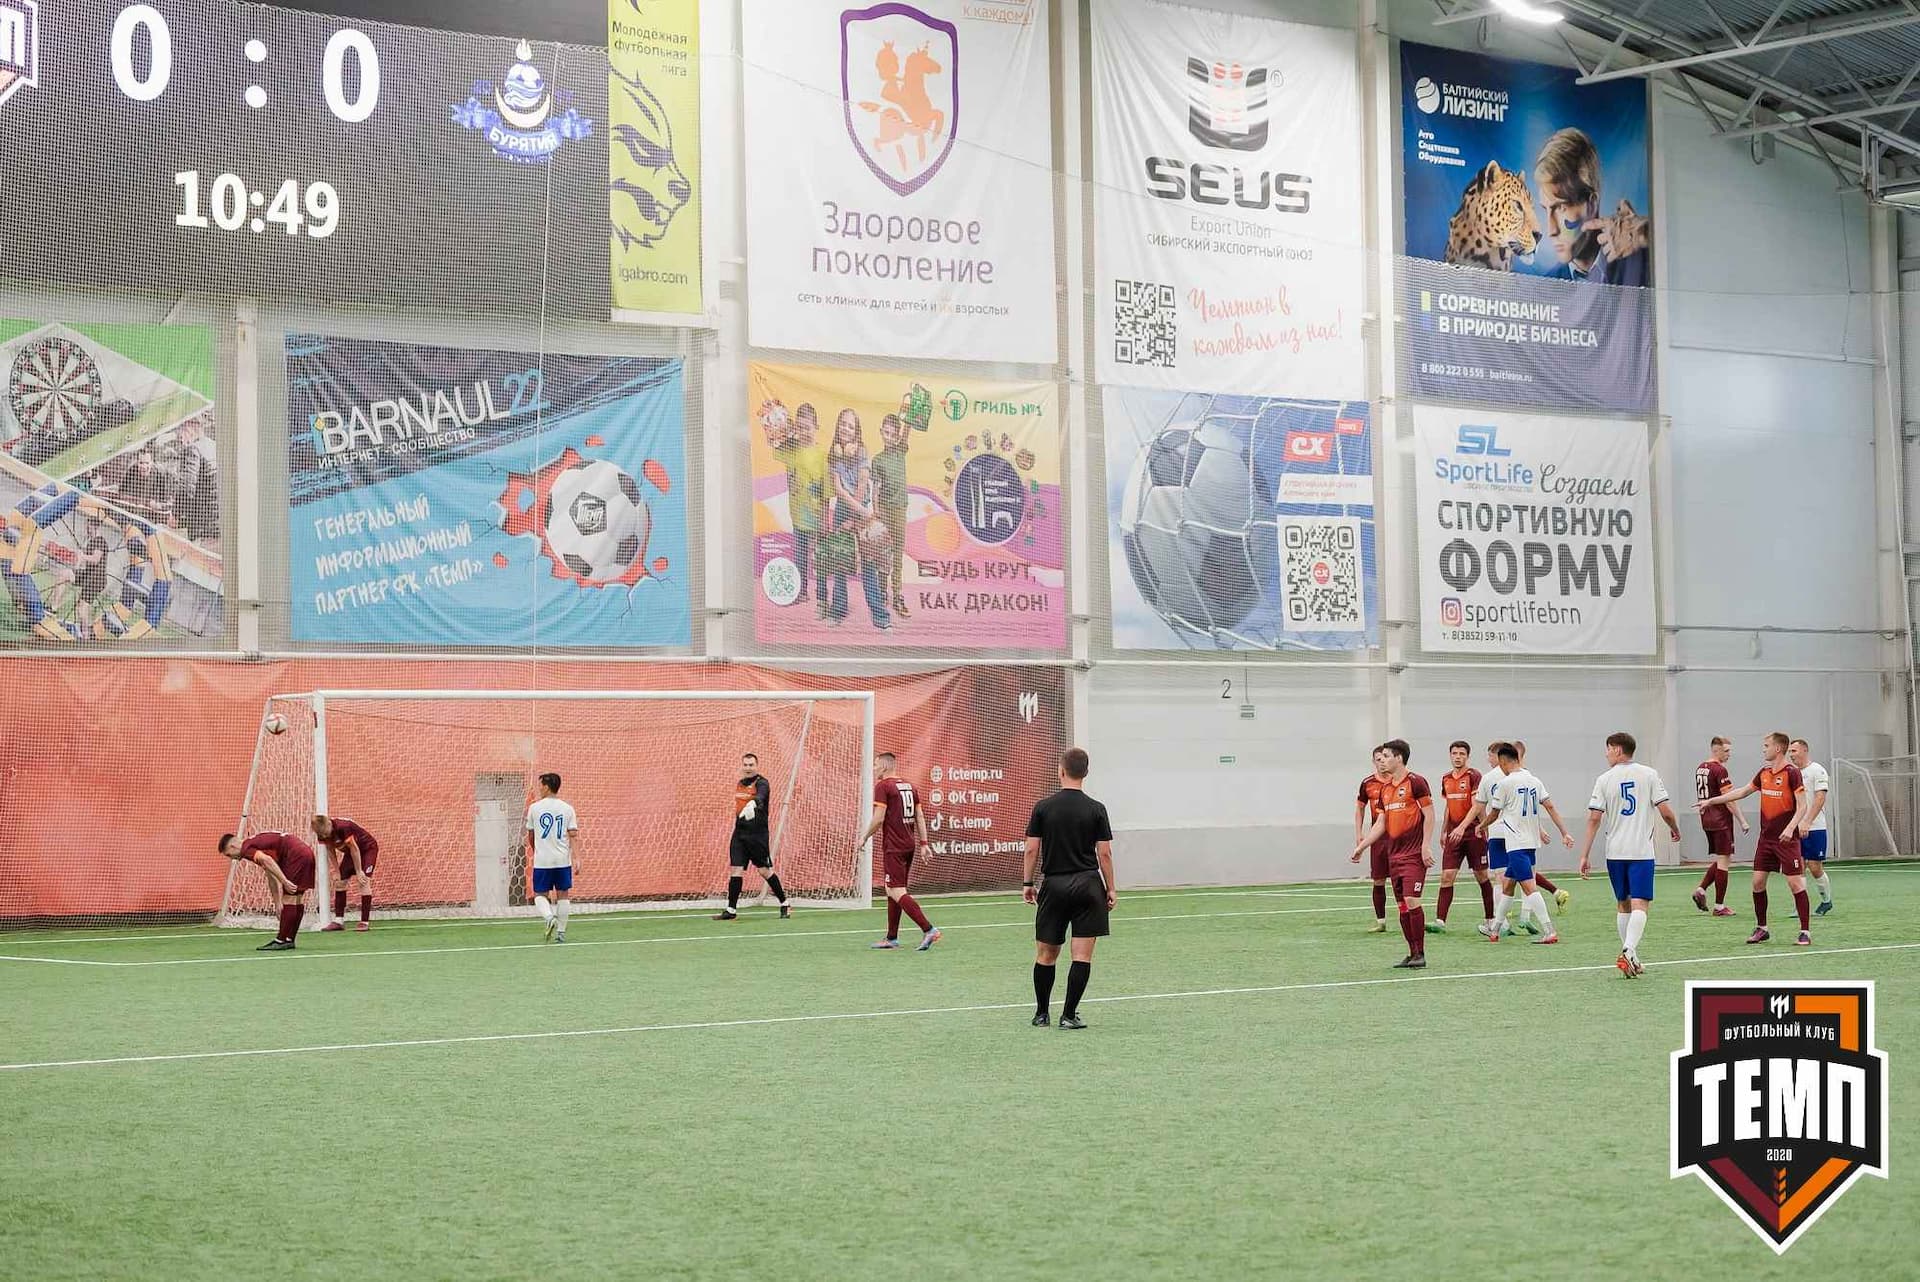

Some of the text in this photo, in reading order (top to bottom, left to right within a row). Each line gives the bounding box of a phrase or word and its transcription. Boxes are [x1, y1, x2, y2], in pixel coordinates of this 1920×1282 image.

[612, 20, 687, 44] Молодёжная
[614, 38, 687, 60] футбольная
[110, 4, 172, 101] 0
[322, 28, 380, 122] 0
[661, 64, 687, 77] лига
[1442, 83, 1508, 104] БАЛТИЙСКИЙ
[1442, 95, 1508, 122] ЛИЗИНГ
[489, 125, 559, 151] БУРЯТИЯ
[1145, 156, 1312, 214] SEUS
[173, 170, 340, 239] 10:49
[822, 200, 981, 246] Здоровое
[1191, 215, 1272, 239] Export Union
[1147, 233, 1210, 252] СИБИРСКИЙ
[1213, 241, 1283, 258] ЭКСПОРТНЫЙ
[811, 247, 994, 284] поколение
[798, 292, 822, 304] сеть
[825, 295, 867, 309] клиник
[869, 299, 891, 311] для
[894, 301, 927, 313] детей
[955, 304, 1009, 317] взрослых
[1438, 293, 1560, 323] СОРЕВНОВАНИЕ
[1439, 316, 1598, 348] В ПРИРОДЕ БИЗНЕСА
[973, 400, 1043, 417] ГРИЛЬ №1
[1456, 424, 1512, 457] SL
[1435, 458, 1534, 485] SportLife
[1540, 463, 1640, 505] Создаем
[314, 492, 430, 542] ГЕНЕРАЛЬНЫЙ
[1437, 500, 1634, 537] СПОРТИВНУЮ
[316, 520, 473, 580] ИНФОРМАЦИОННЫЙ
[917, 560, 1037, 583] БУДЬ КРУТ,
[1439, 537, 1633, 598] ФОРМУ
[315, 559, 484, 615] ПАРТНЕР ФК «ТЕМП»
[919, 592, 1049, 614] КАК ДРАКОН!
[1465, 599, 1581, 628] sportlifebrn
[1451, 630, 1484, 642] 8(3852)
[1485, 631, 1518, 642] 59-11-10
[1222, 678, 1233, 699] 2
[948, 767, 1003, 782] fctemp.ru
[901, 790, 915, 818] 19
[948, 790, 999, 803] ФК Темп
[1518, 787, 1538, 817] 71
[1620, 780, 1637, 816] 5
[539, 812, 564, 840] 91
[949, 816, 992, 831] fc.temp
[950, 839, 1025, 856] fctemp_barna
